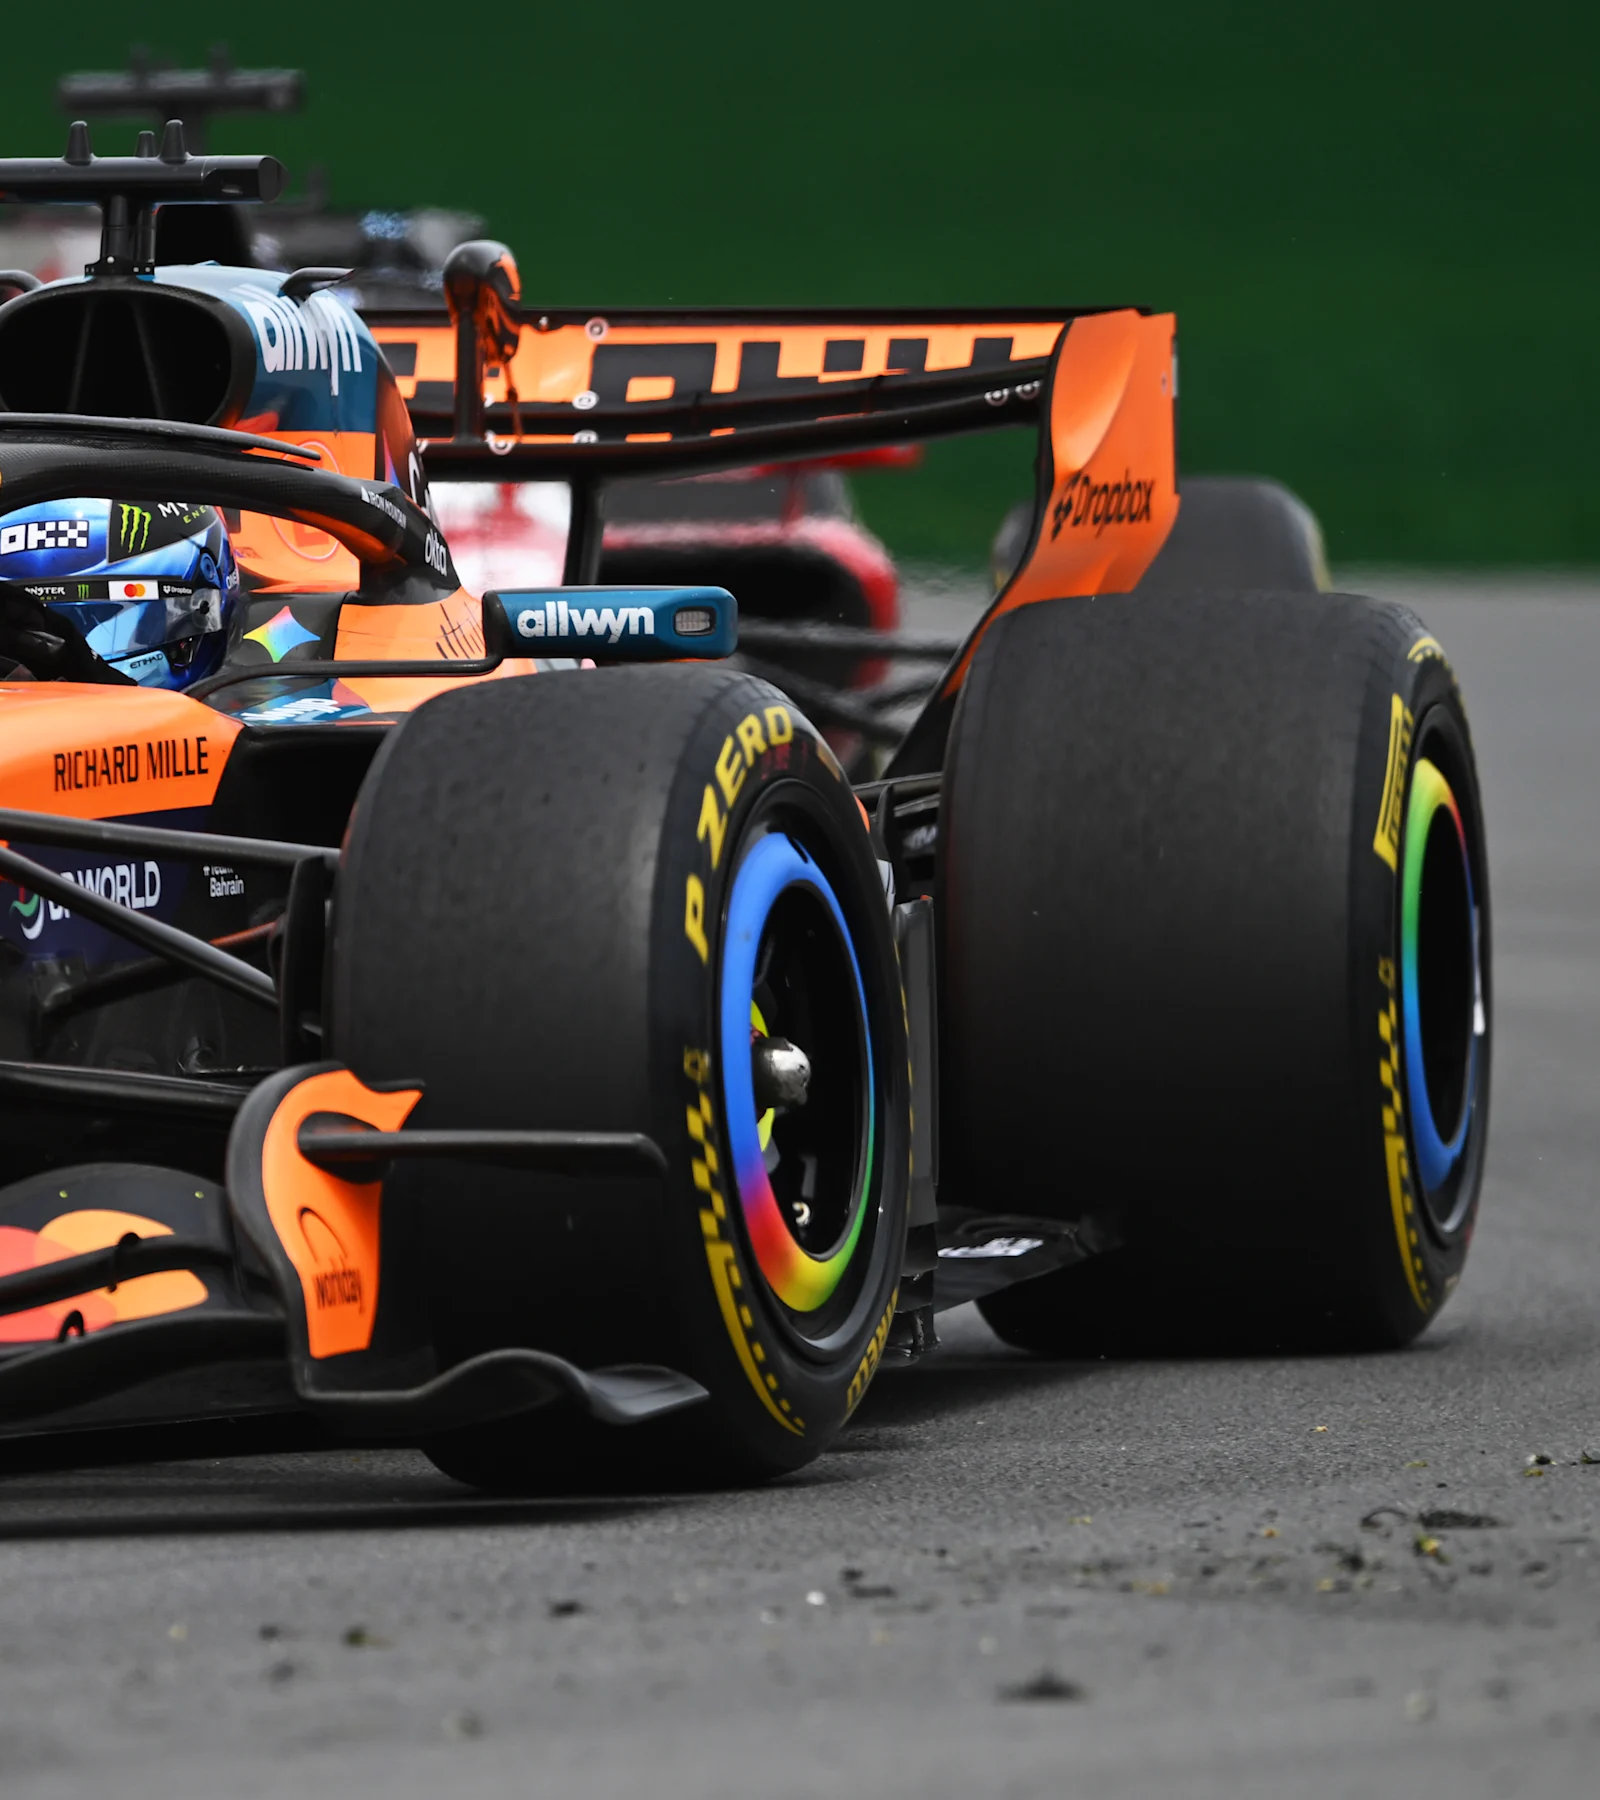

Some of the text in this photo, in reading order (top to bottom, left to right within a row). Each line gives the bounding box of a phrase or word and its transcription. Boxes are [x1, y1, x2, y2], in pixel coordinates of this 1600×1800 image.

[1071, 466, 1156, 540] Dropbox
[0, 520, 89, 555] OKX
[424, 528, 448, 577] okta
[170, 586, 193, 595] Dropbox
[516, 600, 655, 644] allwyn
[129, 653, 164, 670] ETIHAD
[53, 736, 209, 792] RICHARD MILLE
[684, 872, 709, 965] P
[697, 705, 794, 873] ZERO
[76, 860, 162, 911] WORLD
[209, 874, 245, 898] Bahrain
[312, 1255, 365, 1315] workday
